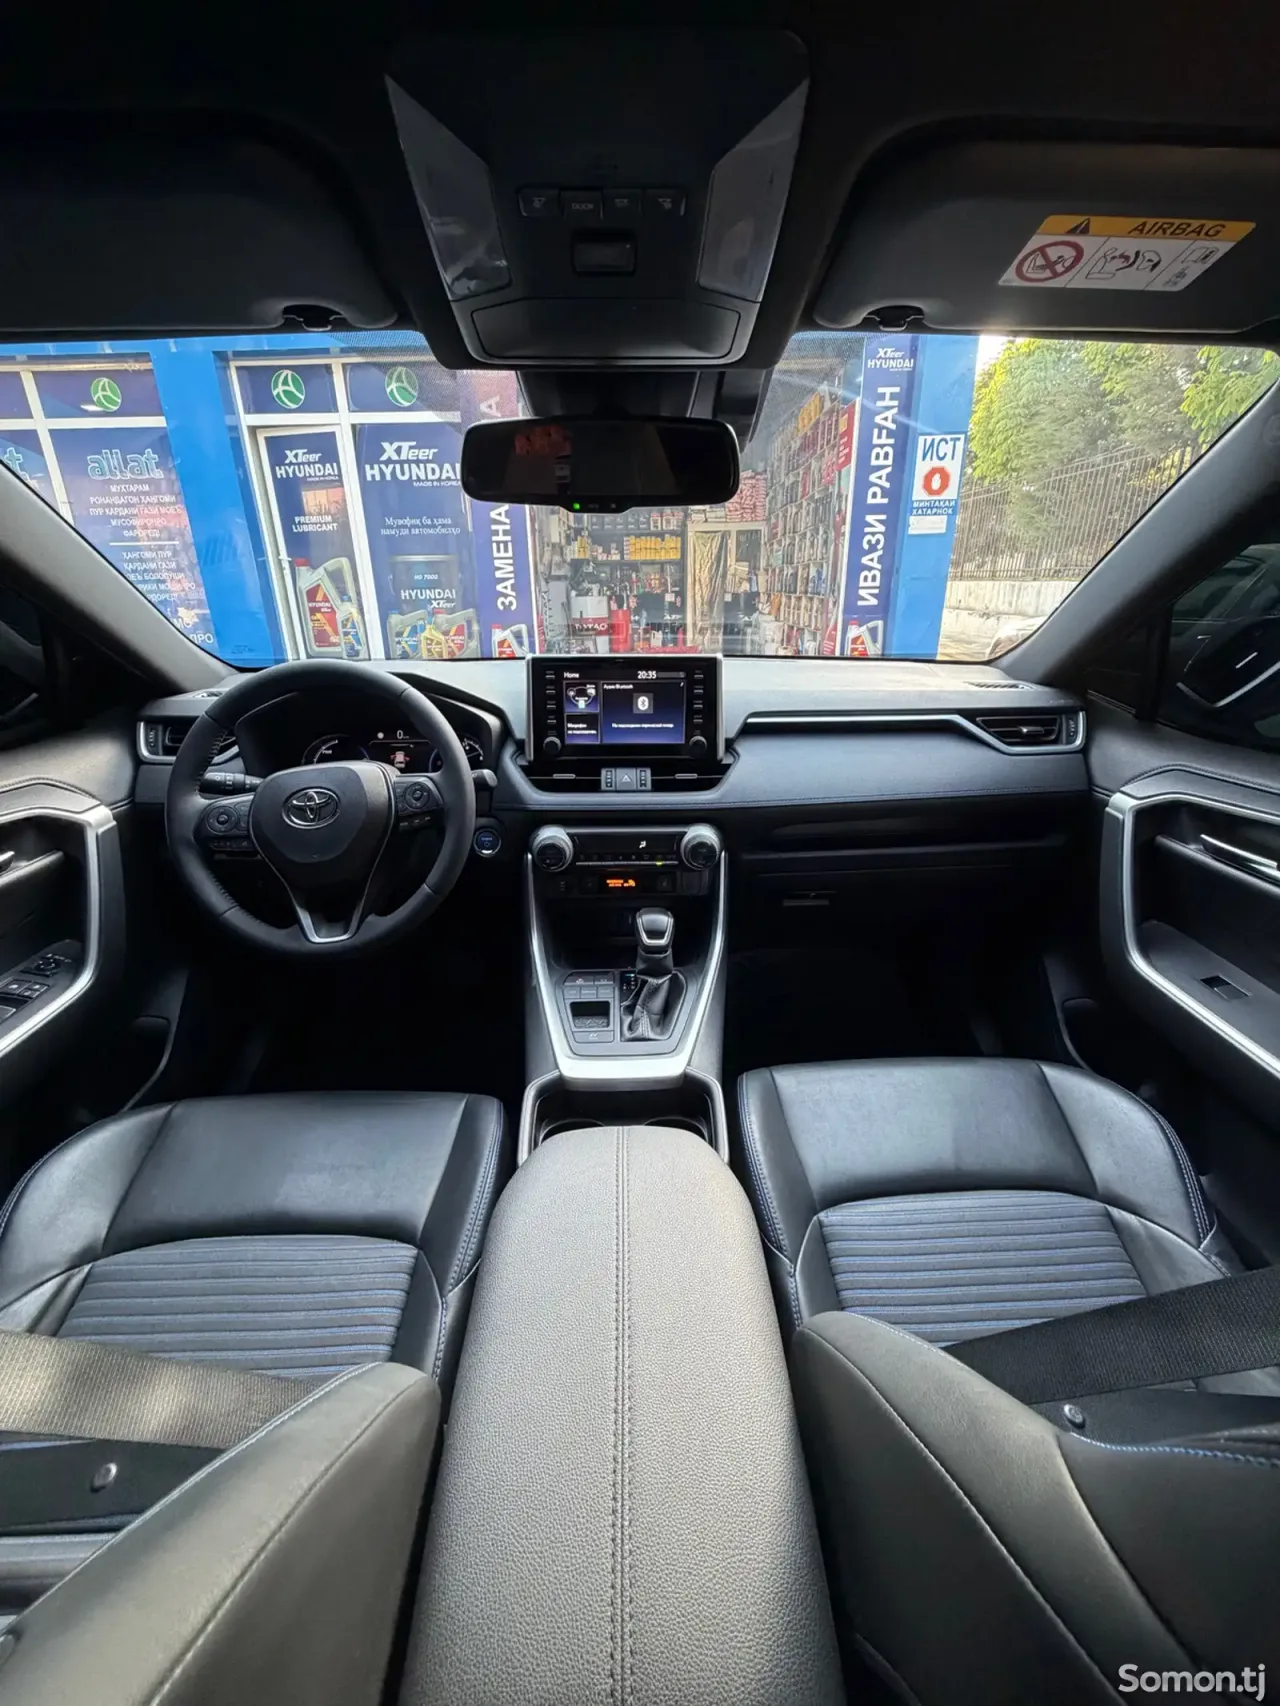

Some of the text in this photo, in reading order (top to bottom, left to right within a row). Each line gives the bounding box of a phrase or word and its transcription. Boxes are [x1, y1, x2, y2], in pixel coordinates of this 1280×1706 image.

[1128, 221, 1226, 237] AIRBAG
[876, 347, 905, 358] XTeer
[867, 359, 914, 369] HYUNDAI
[284, 449, 322, 463] XTeer
[379, 441, 438, 461] XTeer
[921, 437, 961, 462] ИСТ
[275, 462, 338, 479] HYUNDAI
[364, 463, 461, 481] HYUNDAI
[294, 515, 333, 525] PREMIUM
[292, 523, 338, 533] LUBRICANT
[489, 503, 517, 611] ЗАМЕНА
[857, 514, 886, 606] ИВАЗИ
[401, 589, 456, 600] HYUNDAI
[430, 600, 456, 609] XTeer
[637, 670, 657, 679] 20:35
